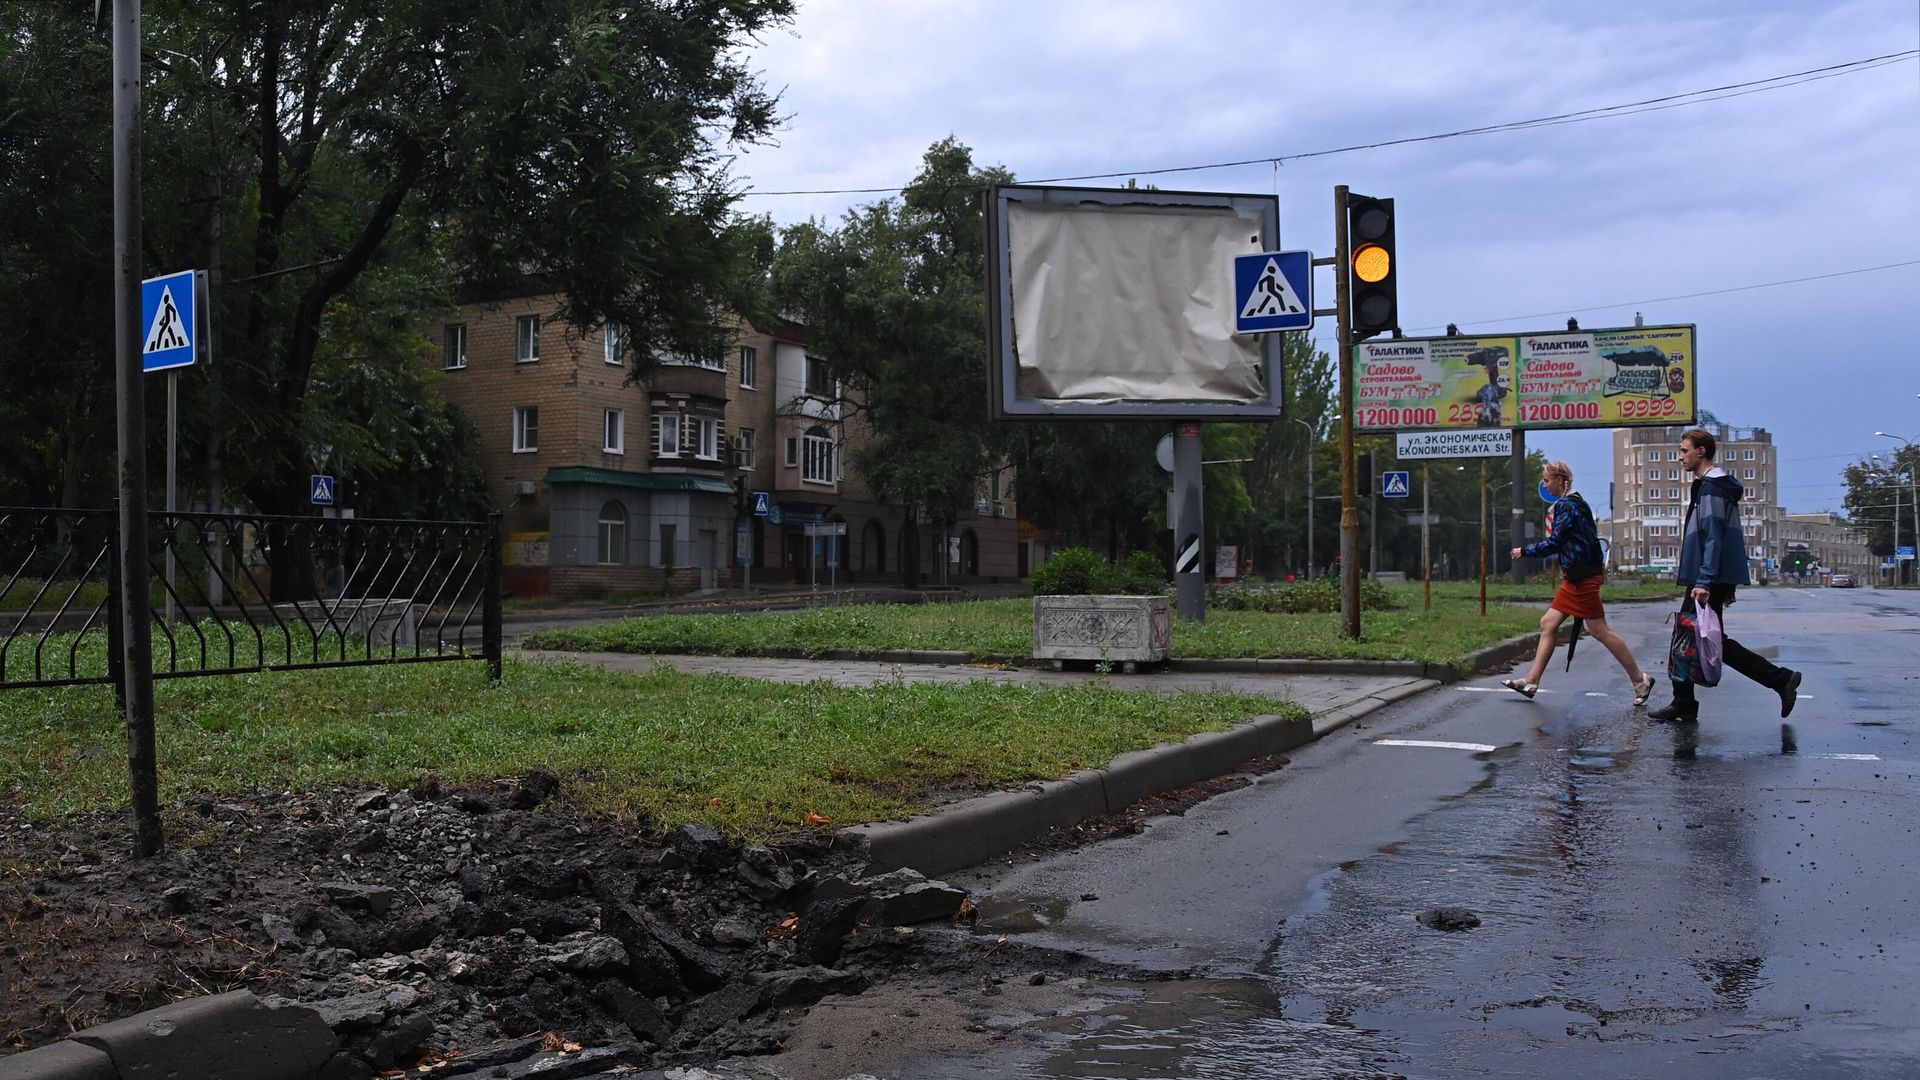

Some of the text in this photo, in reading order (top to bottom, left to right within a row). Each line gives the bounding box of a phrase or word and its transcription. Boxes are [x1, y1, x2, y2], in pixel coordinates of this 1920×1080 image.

[1370, 346, 1424, 357] ГАЛАКТИКА
[1532, 340, 1589, 351] ГАЛАКТИКА
[1367, 363, 1415, 376] Садово
[1526, 359, 1575, 372] Садово
[1360, 386, 1389, 397] БУМ
[1520, 382, 1549, 393] БУМ
[1616, 398, 1676, 418] 19999
[1408, 432, 1511, 447] ул. ЭКОНОМИЧЕСКАЯ
[1399, 443, 1510, 456] EKONOMICHESKAYA Str.
